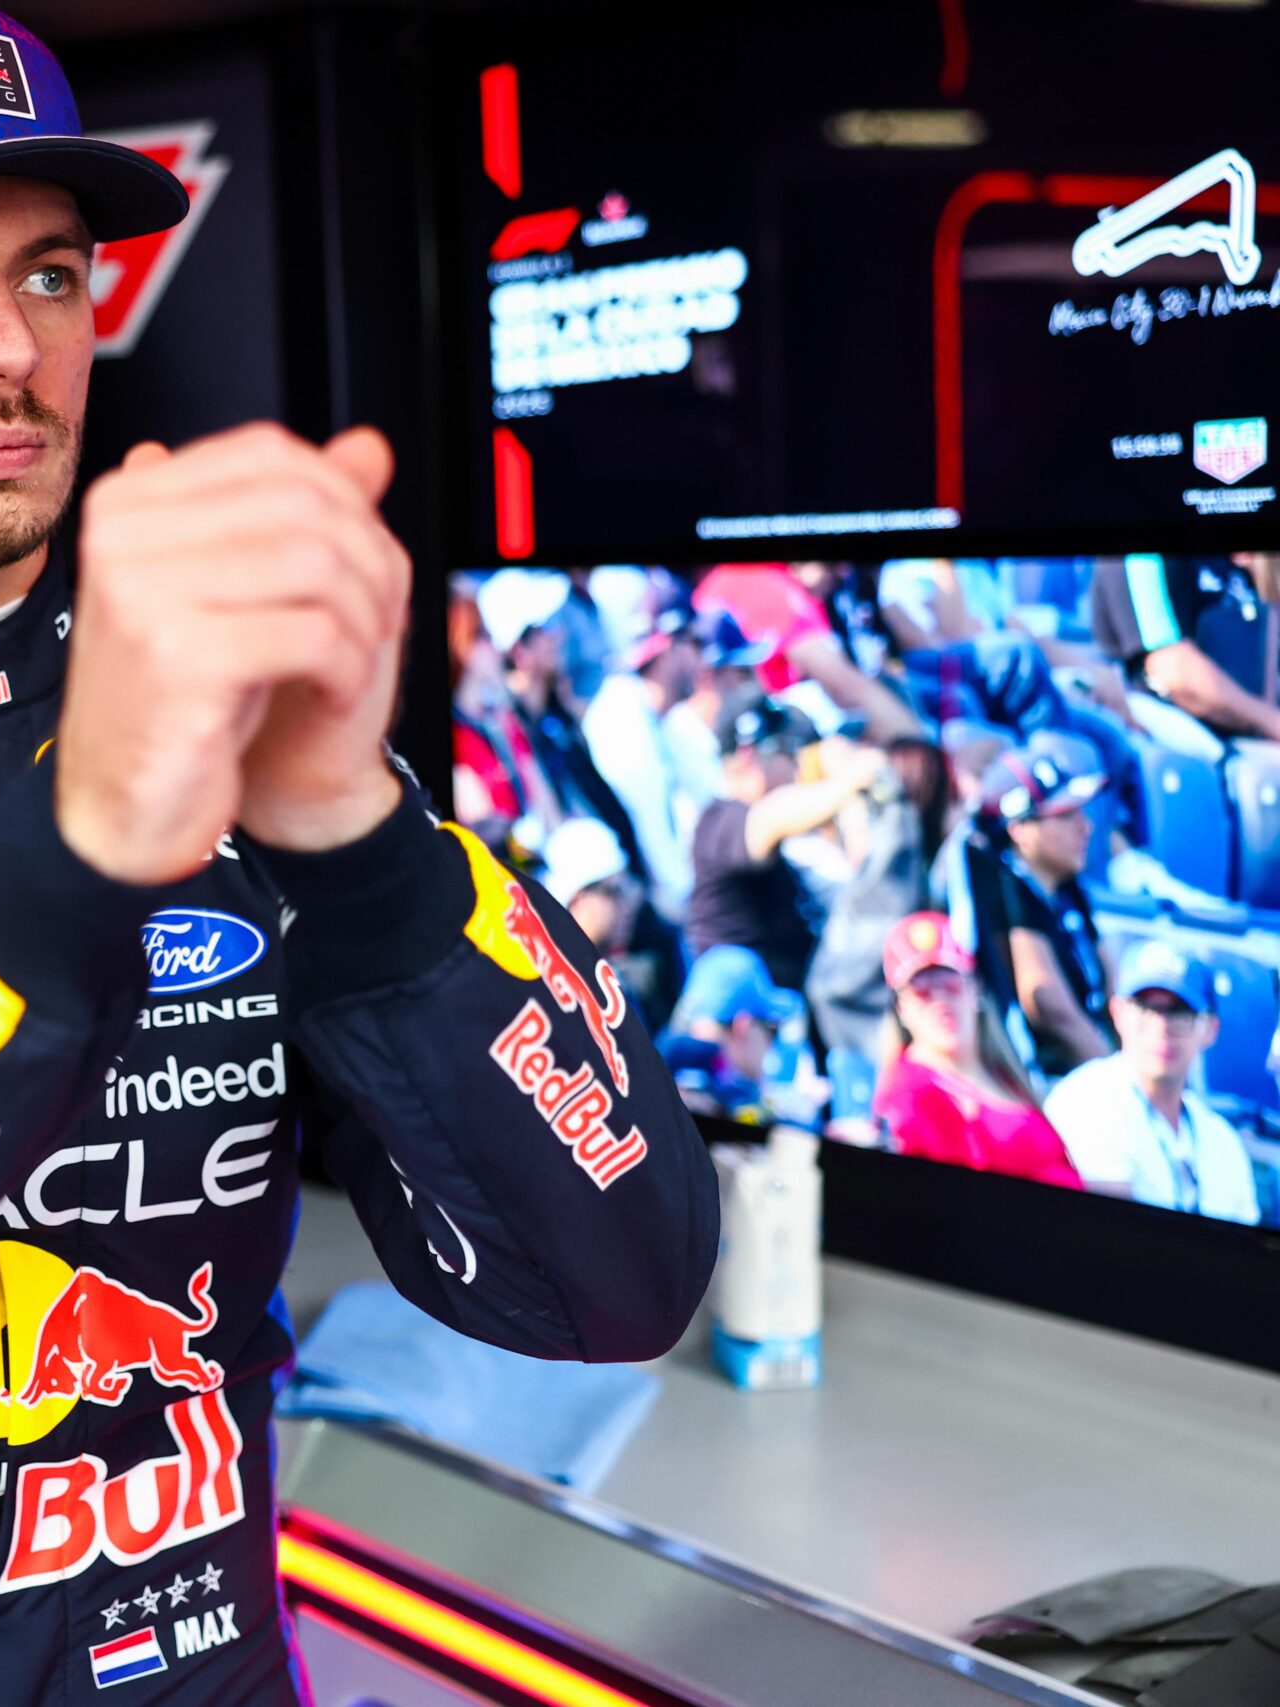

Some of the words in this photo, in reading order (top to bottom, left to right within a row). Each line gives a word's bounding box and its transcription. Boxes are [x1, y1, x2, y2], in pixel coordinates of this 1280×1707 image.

[139, 921, 222, 978] Ford
[135, 993, 279, 1030] CING
[104, 1042, 286, 1120] indeed
[489, 997, 594, 1124] Red
[550, 1078, 648, 1192] Bull
[175, 1603, 240, 1659] MAX
